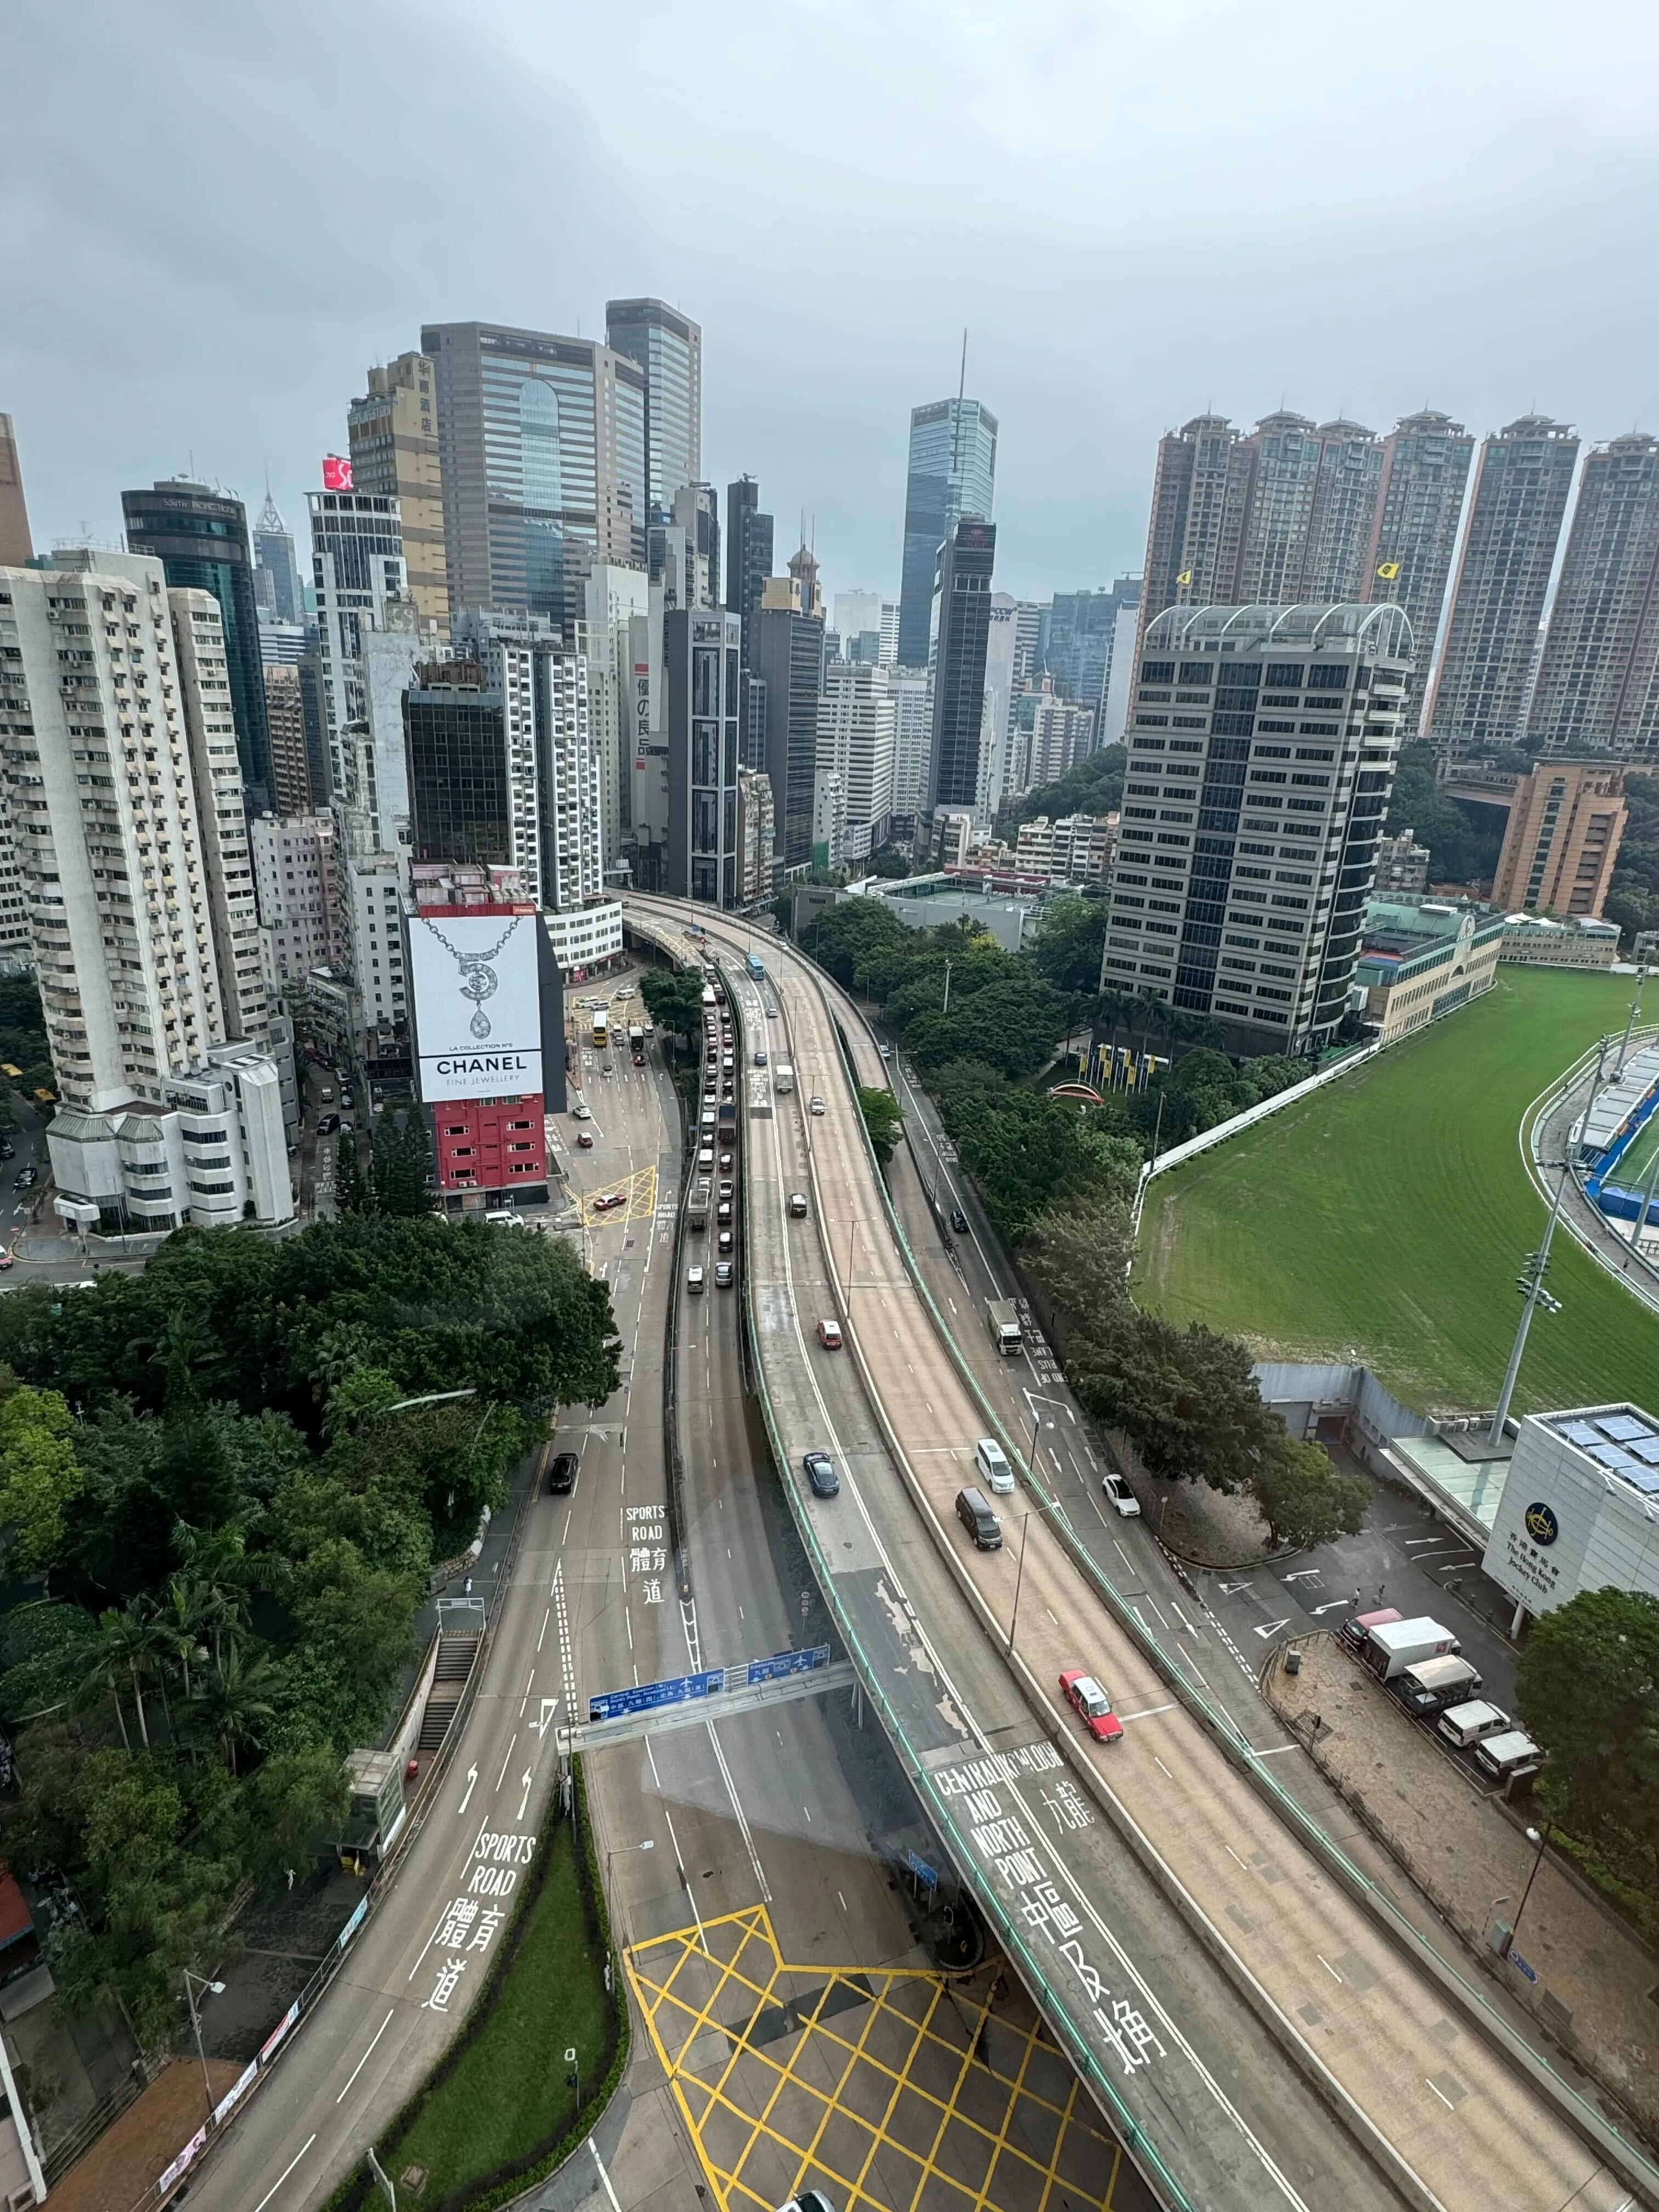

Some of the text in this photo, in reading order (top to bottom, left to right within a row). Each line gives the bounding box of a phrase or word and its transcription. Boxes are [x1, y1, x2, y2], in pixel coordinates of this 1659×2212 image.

[163, 498, 187, 508] SOUTH
[437, 1056, 527, 1074] CHANEL
[471, 1075, 521, 1085] JEWELLERY
[1024, 1329, 1045, 1344] 巴士
[1030, 1346, 1053, 1357] LANE
[1037, 1359, 1058, 1369] BUS
[1041, 1373, 1051, 1384] OF
[626, 1505, 665, 1521] SPORTS
[632, 1525, 663, 1541] ROAD
[630, 1547, 667, 1572] 體育
[1507, 1541, 1556, 1590] The Hong Kong
[1509, 1531, 1560, 1576] 香港賽馬會
[643, 1578, 665, 1605] 道
[1507, 1557, 1531, 1581] Jockey
[1531, 1577, 1548, 1594] Club
[934, 1741, 1064, 1796] CENTRAL KOWLOON
[963, 1789, 1003, 1824] AND
[1039, 1781, 1095, 1835] 九龍
[475, 1833, 536, 1864] SPORTS
[970, 1816, 1031, 1858] NORTH
[468, 1865, 517, 1897] ROAD
[994, 1847, 1048, 1889] POINT
[435, 1898, 505, 1952] 體育
[1021, 1881, 1083, 1944] 中區
[421, 1957, 467, 2012] 道
[1058, 1940, 1110, 2002] 及
[1093, 2000, 1167, 2075] 北角
